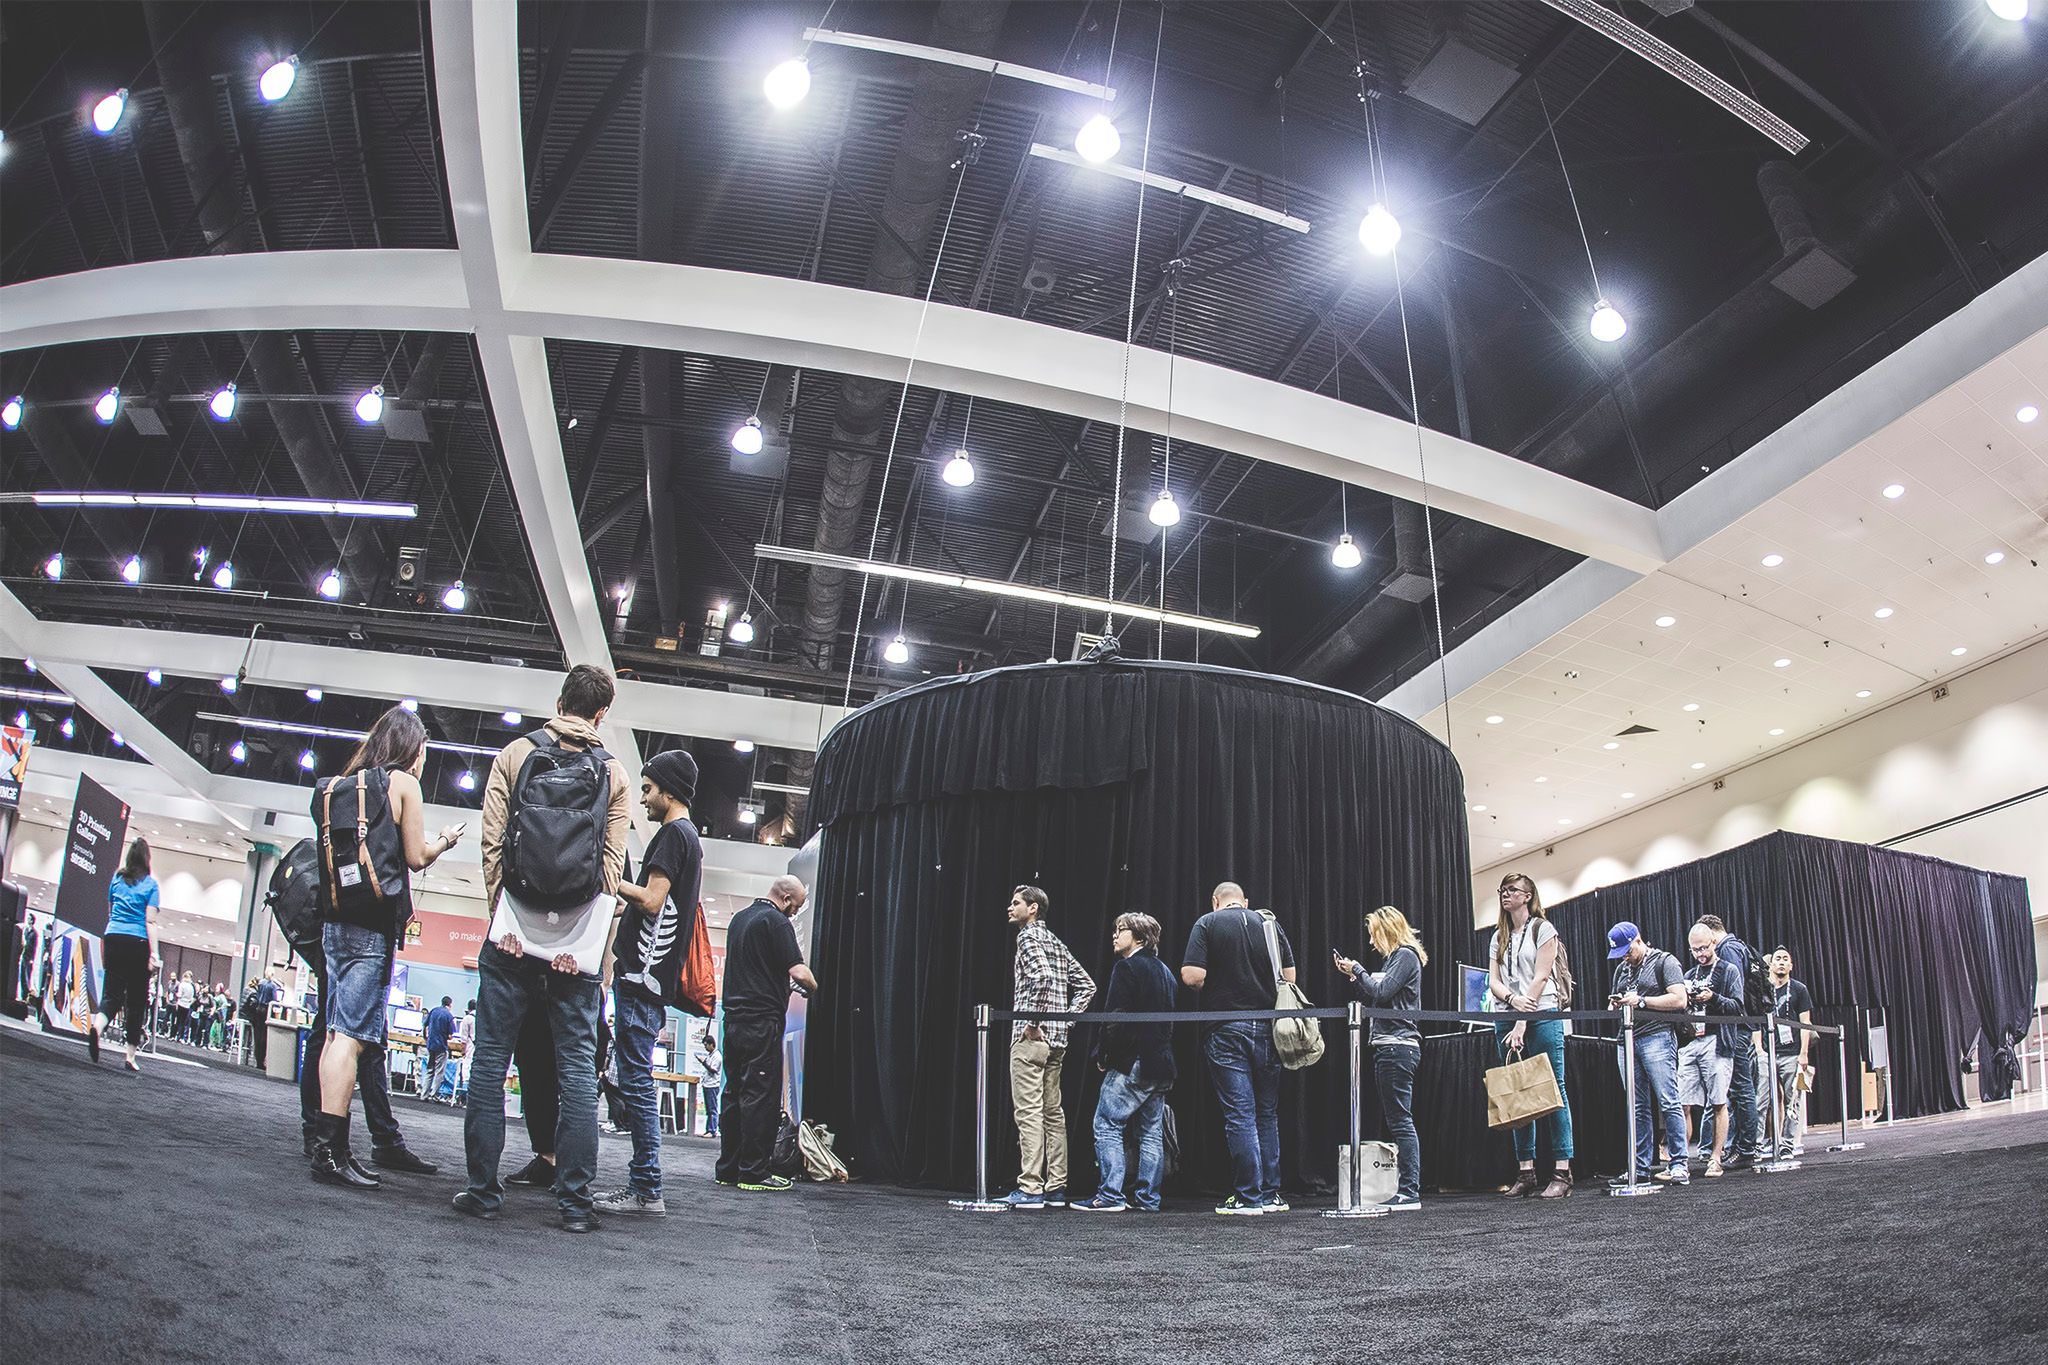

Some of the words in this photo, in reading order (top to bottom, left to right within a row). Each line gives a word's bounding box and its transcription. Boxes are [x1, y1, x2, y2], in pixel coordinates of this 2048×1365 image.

[1935, 687, 1947, 699] 22
[76, 823, 98, 846] Gallery
[79, 809, 88, 824] 3D
[87, 815, 112, 841] Printing
[70, 852, 97, 875] stratasys
[449, 931, 460, 942] go
[460, 932, 482, 943] make
